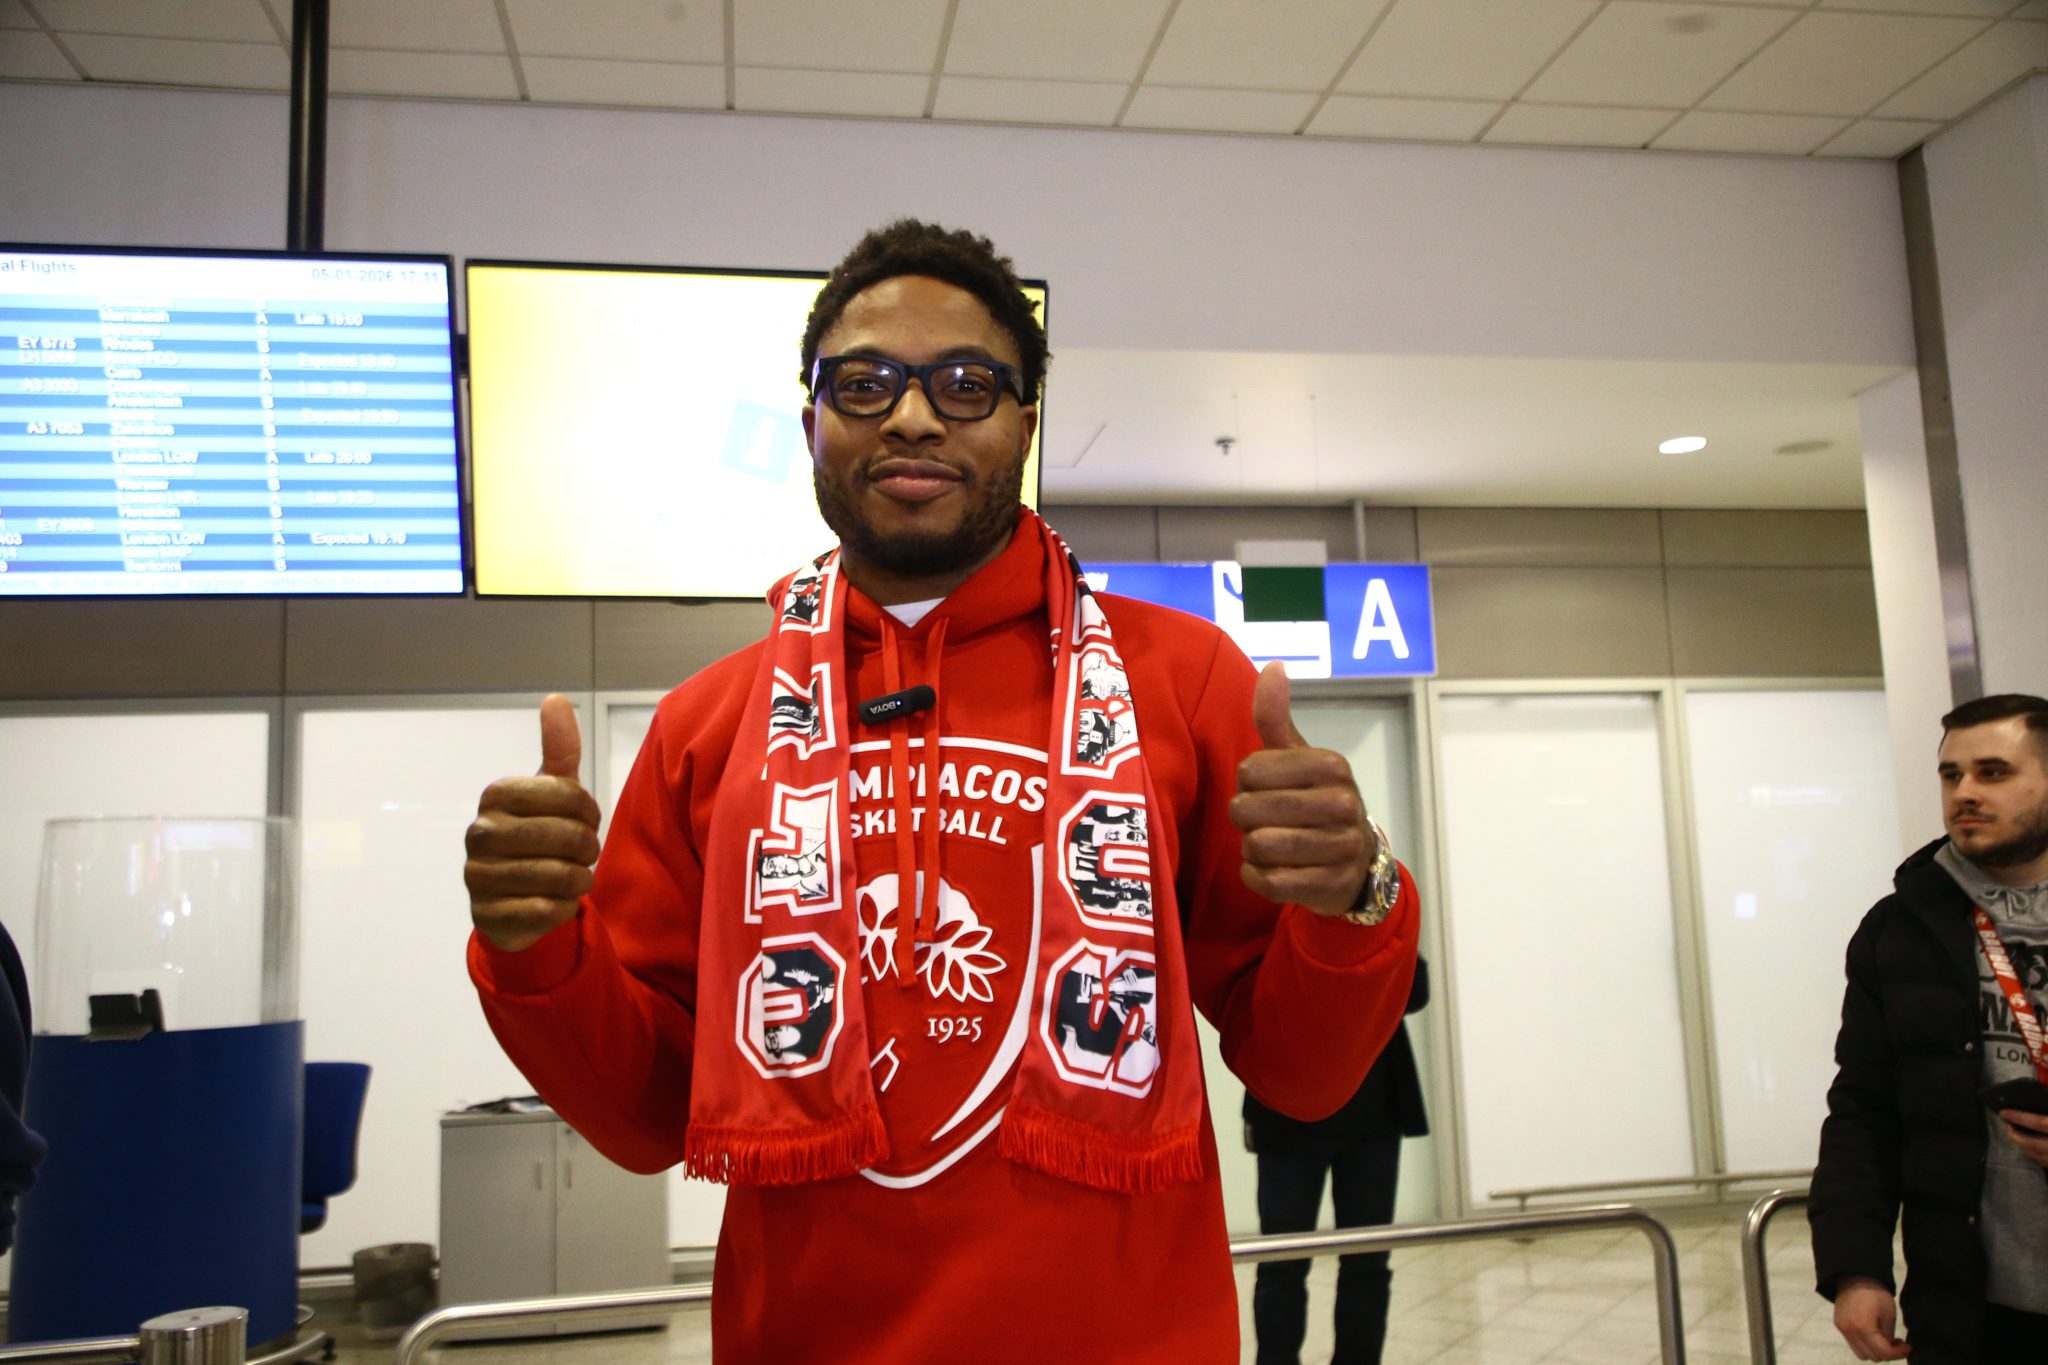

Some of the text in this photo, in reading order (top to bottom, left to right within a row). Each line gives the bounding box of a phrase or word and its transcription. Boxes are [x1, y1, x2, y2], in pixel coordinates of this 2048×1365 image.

[21, 259, 77, 275] Flights
[18, 336, 40, 349] EY
[1352, 578, 1410, 660] A
[870, 701, 896, 714] BOYA
[927, 1017, 983, 1043] 1925
